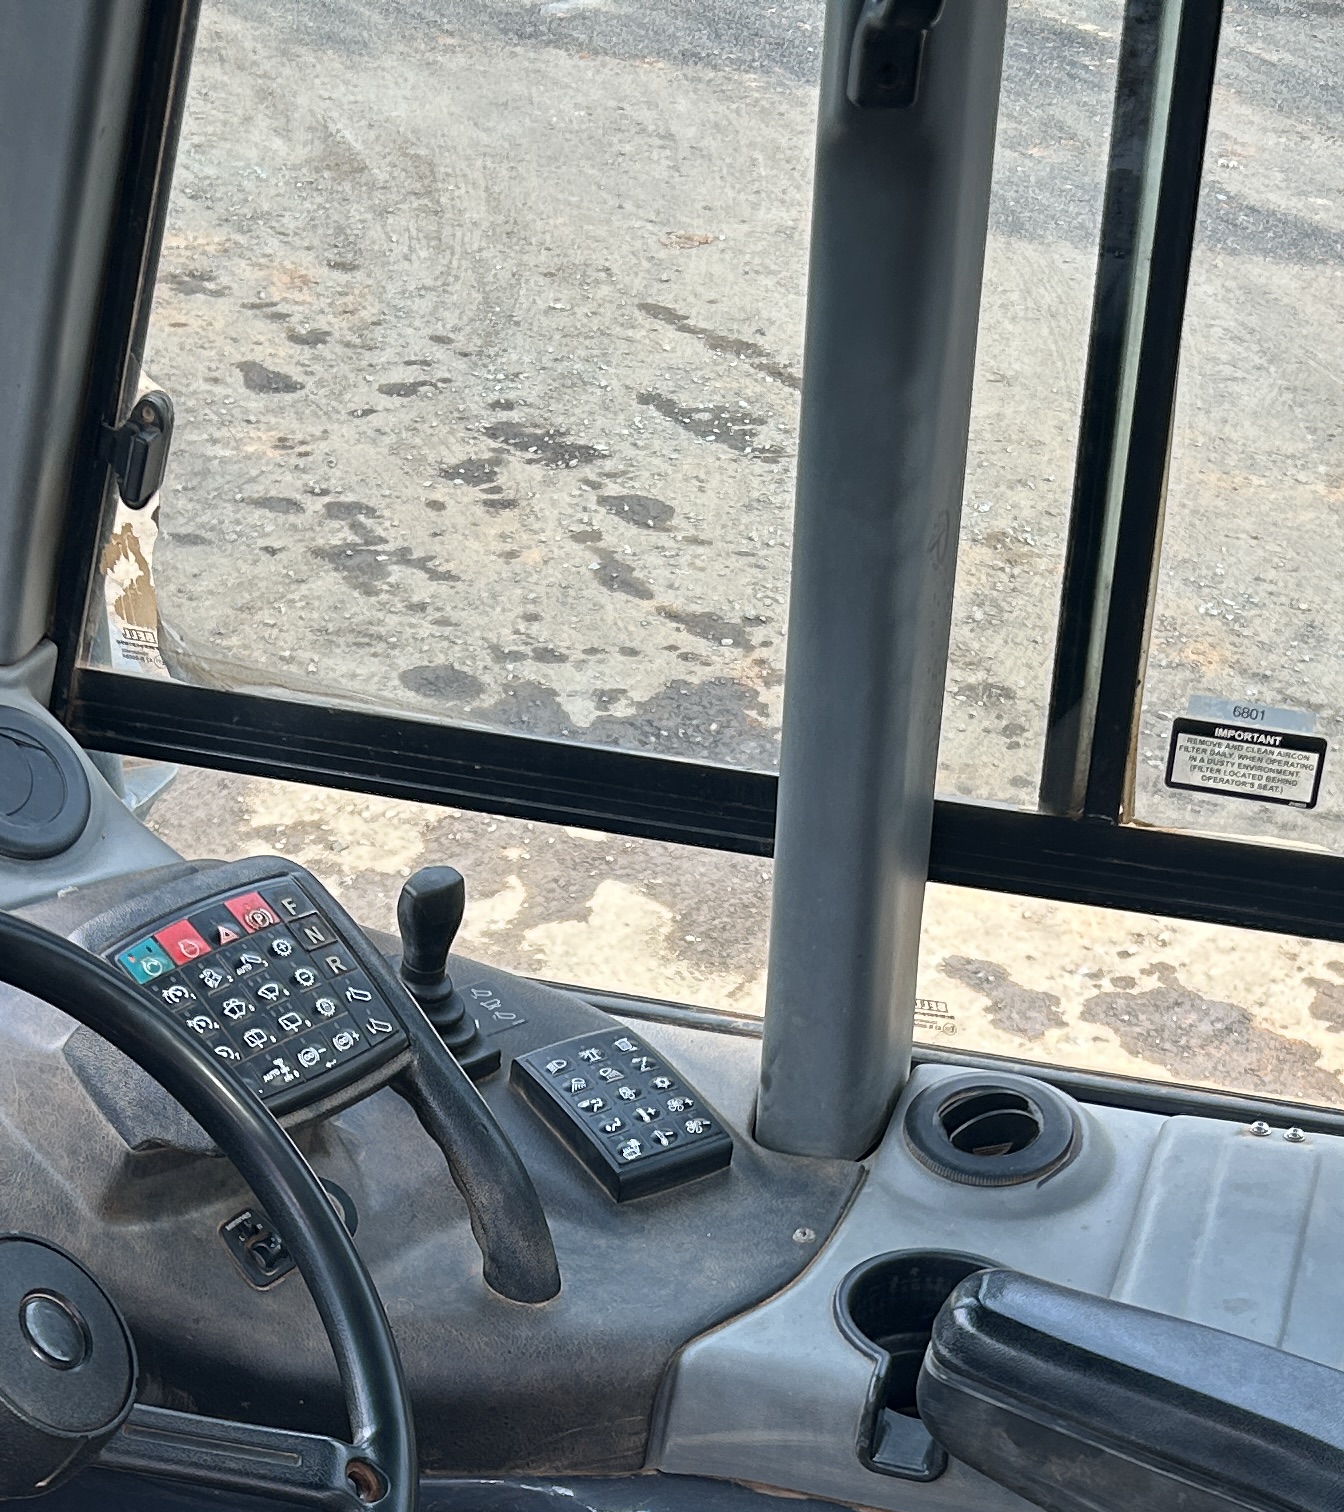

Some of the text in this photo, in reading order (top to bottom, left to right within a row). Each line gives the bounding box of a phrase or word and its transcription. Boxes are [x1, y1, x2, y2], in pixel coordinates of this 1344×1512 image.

[1233, 705, 1265, 721] 6801
[1215, 728, 1283, 746] IMPORTANT
[1179, 745, 1206, 755] FILTER
[1238, 753, 1264, 763] WHEN
[1265, 757, 1314, 771] OPERATING
[1187, 738, 1310, 761] REMOVE AND CLEAN AIRCON
[1207, 758, 1236, 768] DUSTY
[1190, 764, 1298, 787] (FILTER LOCATED BEHIND
[1201, 775, 1284, 794] OPERATOR'S SEAT.)
[282, 897, 300, 915] F
[304, 925, 323, 944] N
[236, 963, 252, 975] AUTO
[327, 954, 345, 973] R
[261, 1068, 280, 1081] AUTO
